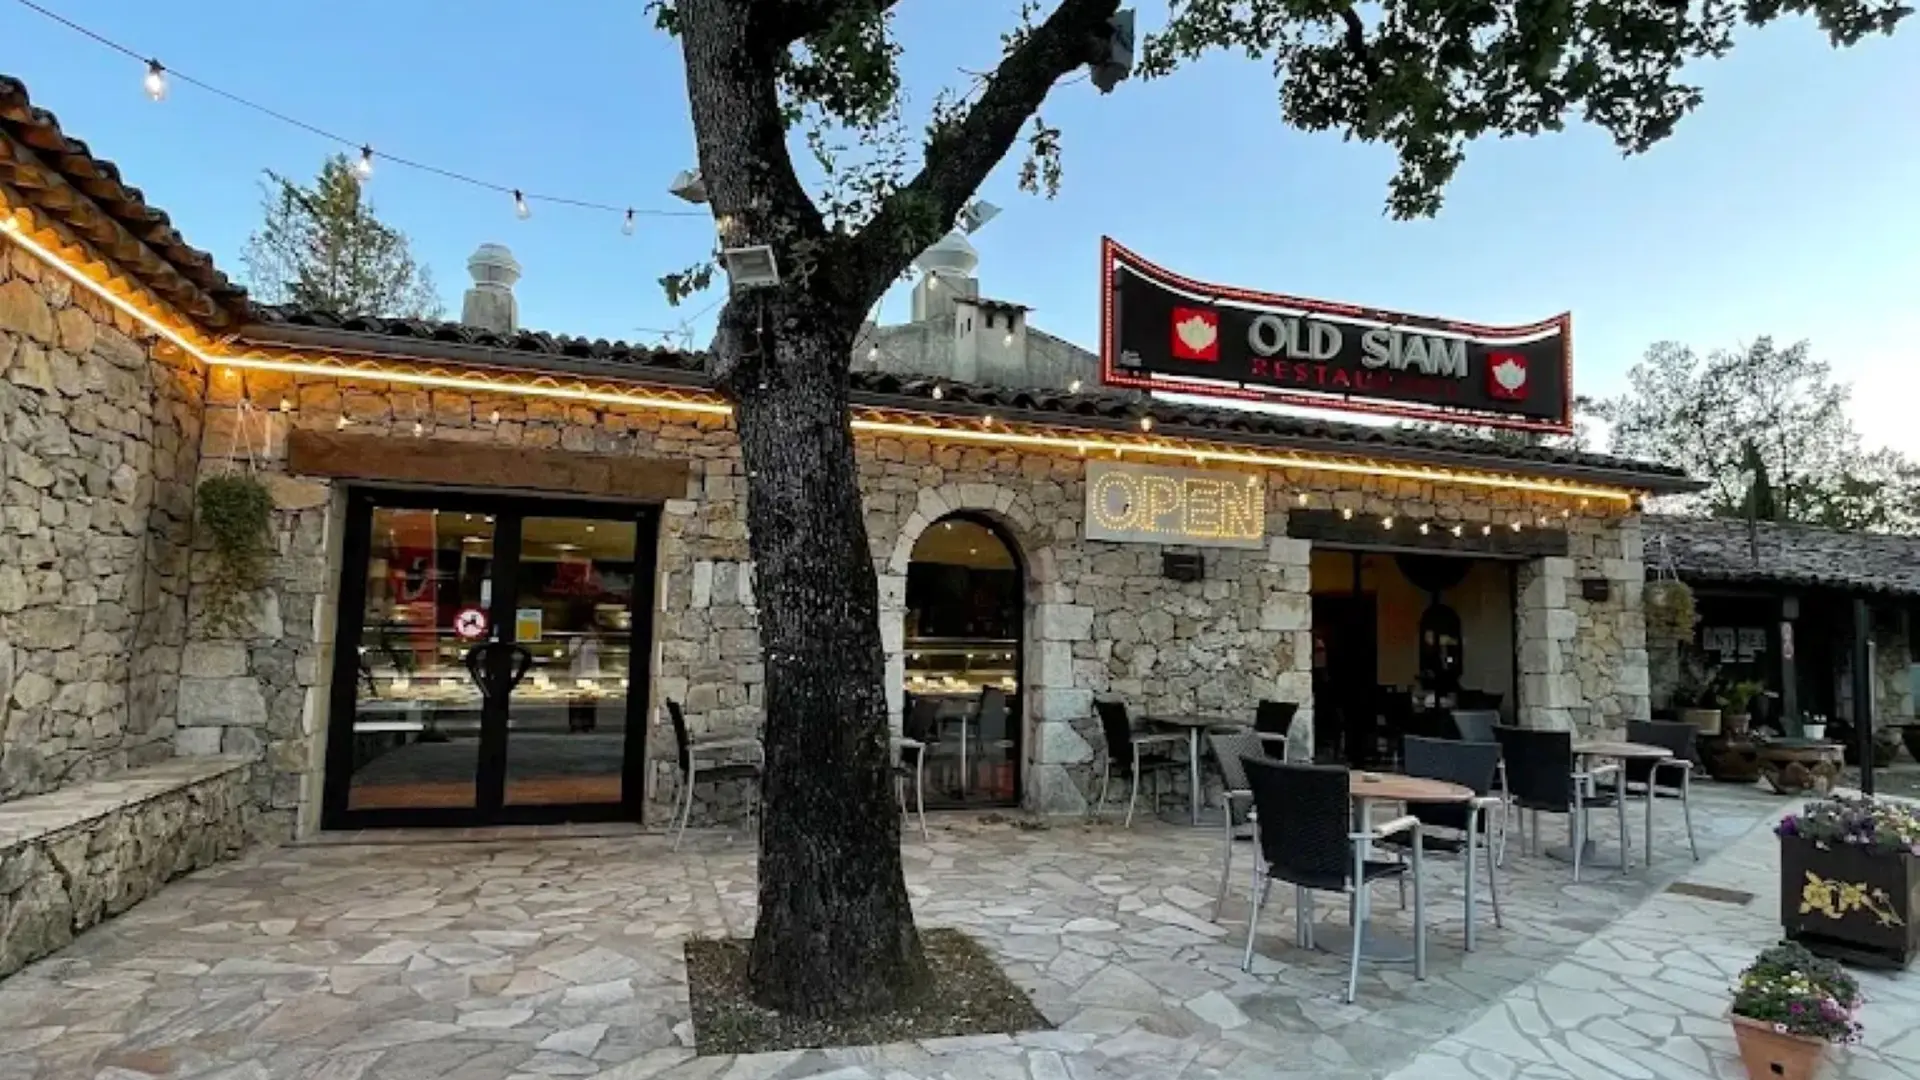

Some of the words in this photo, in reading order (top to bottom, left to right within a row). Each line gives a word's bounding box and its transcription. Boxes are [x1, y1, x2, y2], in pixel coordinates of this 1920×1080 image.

[1248, 314, 1342, 360] OLD
[1361, 327, 1468, 378] SIAM
[1251, 358, 1459, 396] RESTAU
[1092, 471, 1265, 538] OPEN
